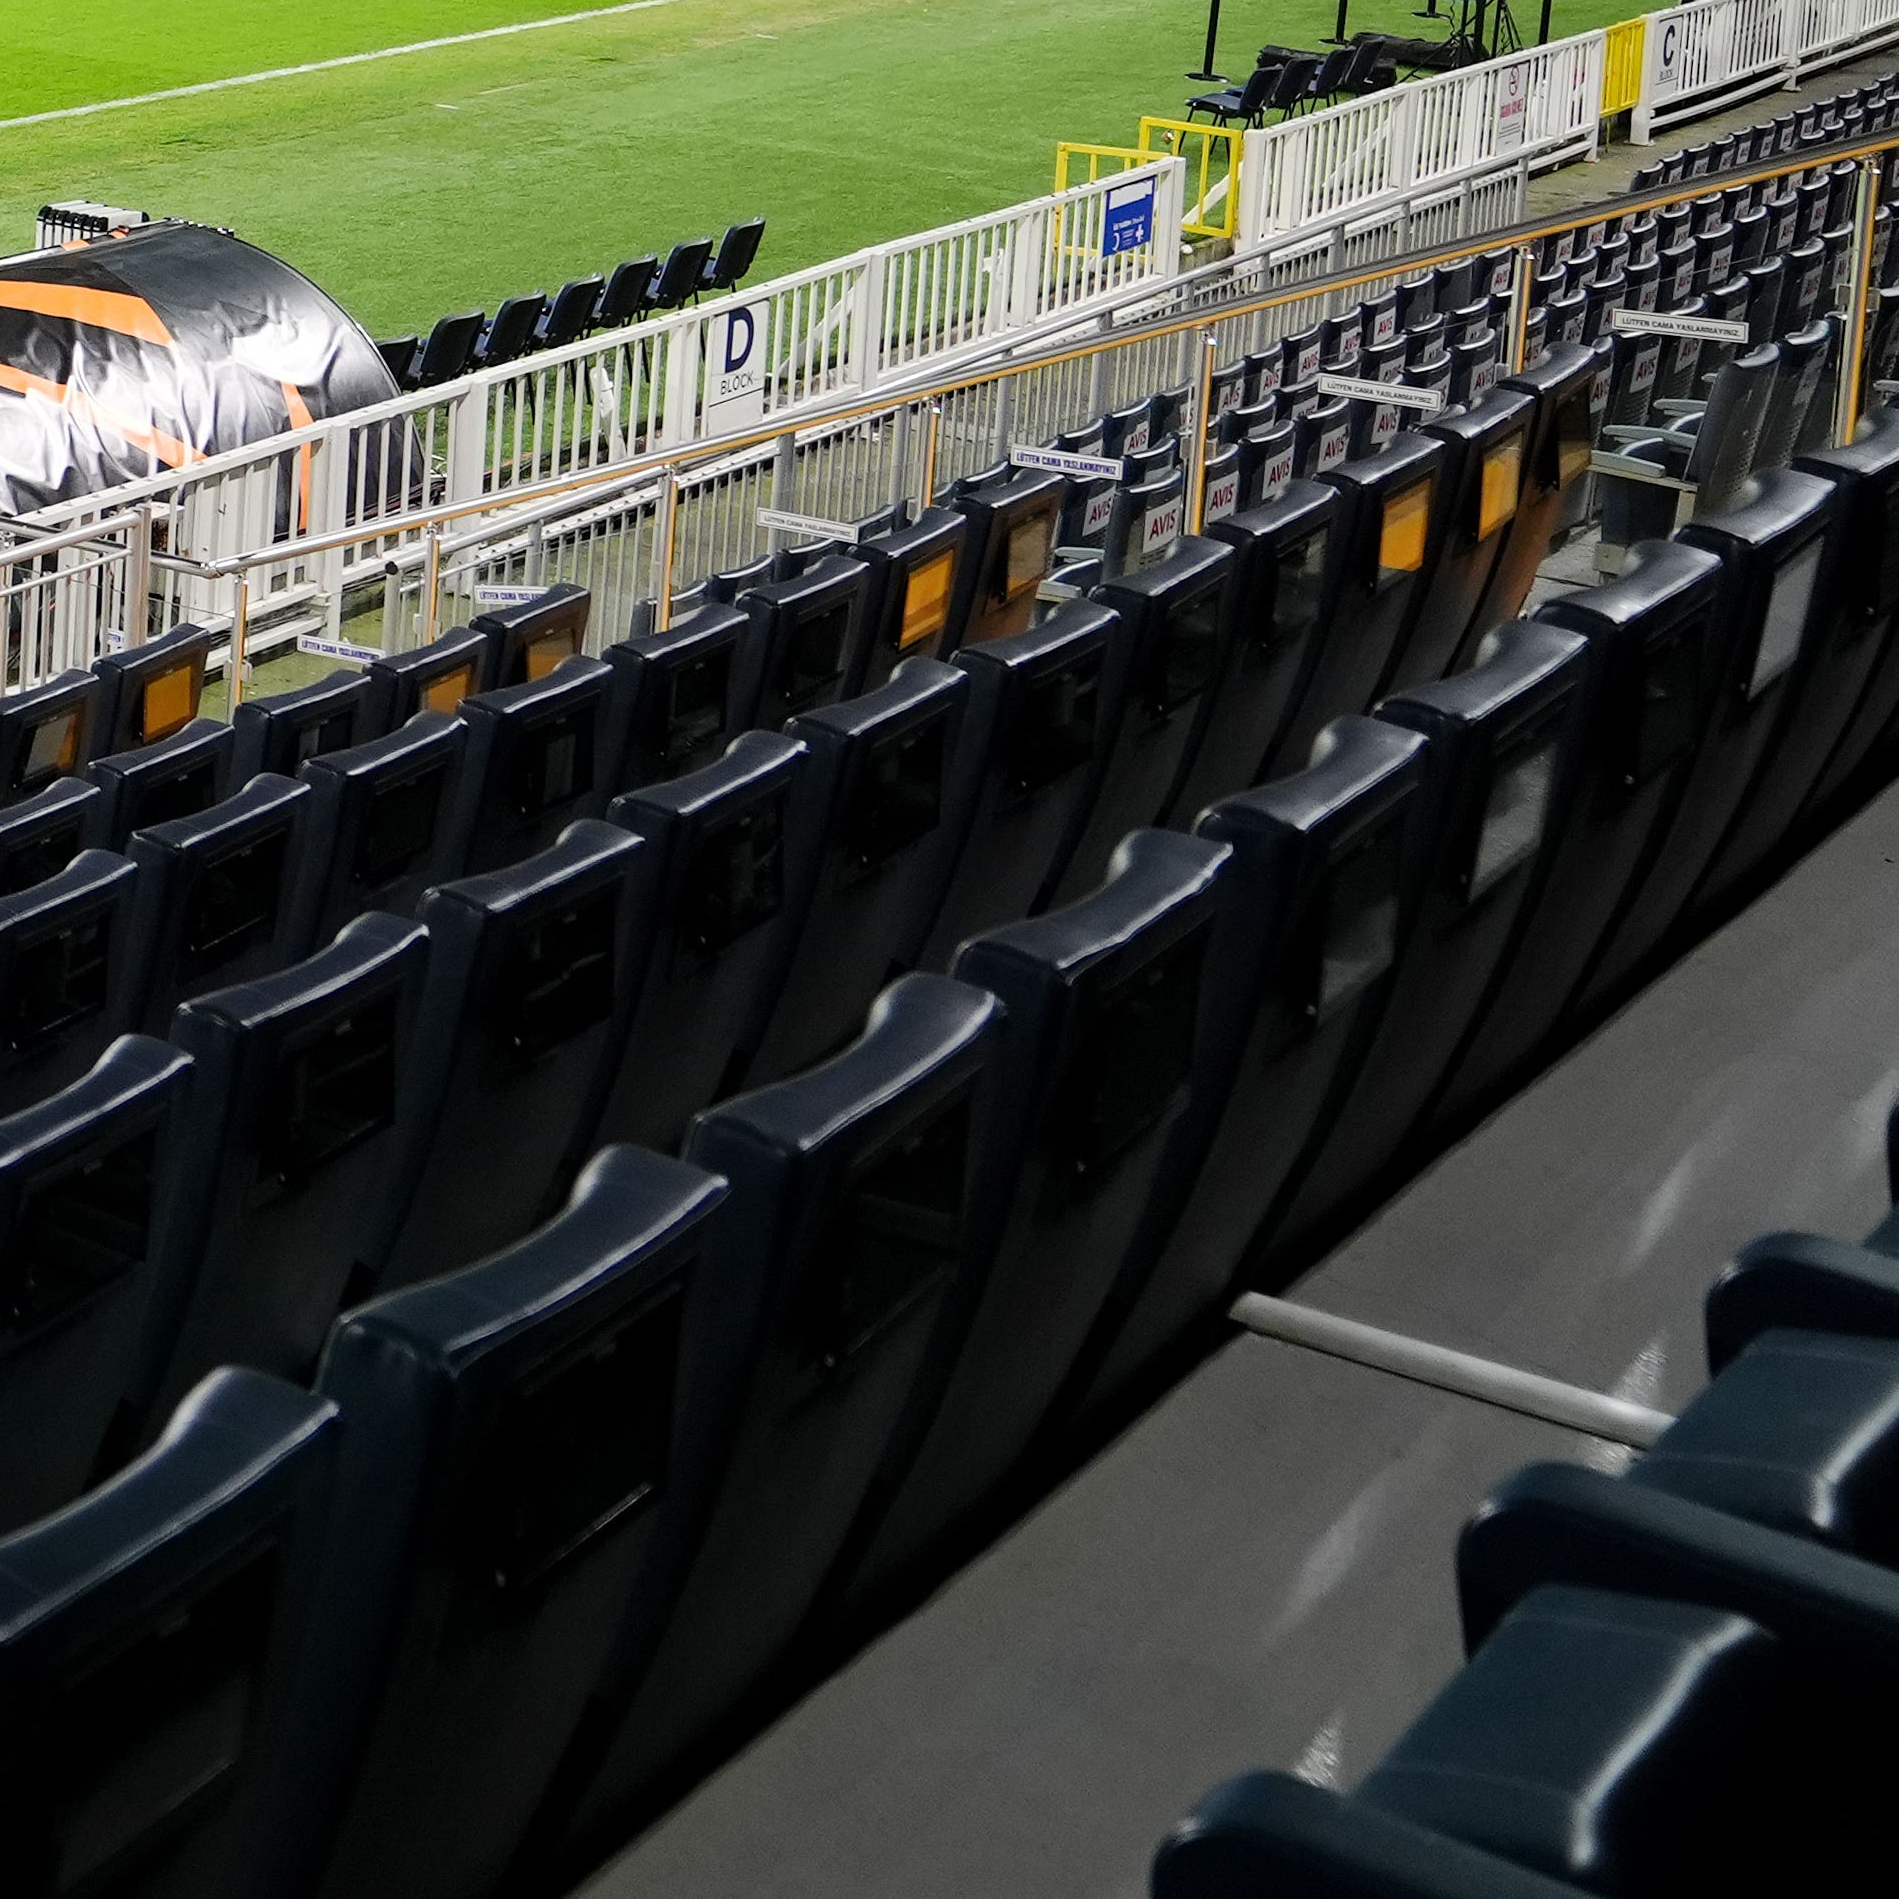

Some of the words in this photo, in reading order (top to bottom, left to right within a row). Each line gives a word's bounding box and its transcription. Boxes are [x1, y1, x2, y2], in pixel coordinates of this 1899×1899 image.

[1663, 25, 1676, 67] C
[1377, 316, 1394, 335] AVIS
[1622, 315, 1650, 328] LÜTFEN
[1651, 318, 1674, 330] CAMA
[723, 307, 753, 373] D
[1302, 351, 1319, 371] AVIS
[720, 371, 755, 395] BLOCK
[1327, 381, 1353, 394] LÜTFEN
[1323, 435, 1348, 461] AVIS
[1268, 462, 1291, 486] AVIS
[1209, 483, 1236, 511] AVIS
[1150, 509, 1177, 538] AVIS
